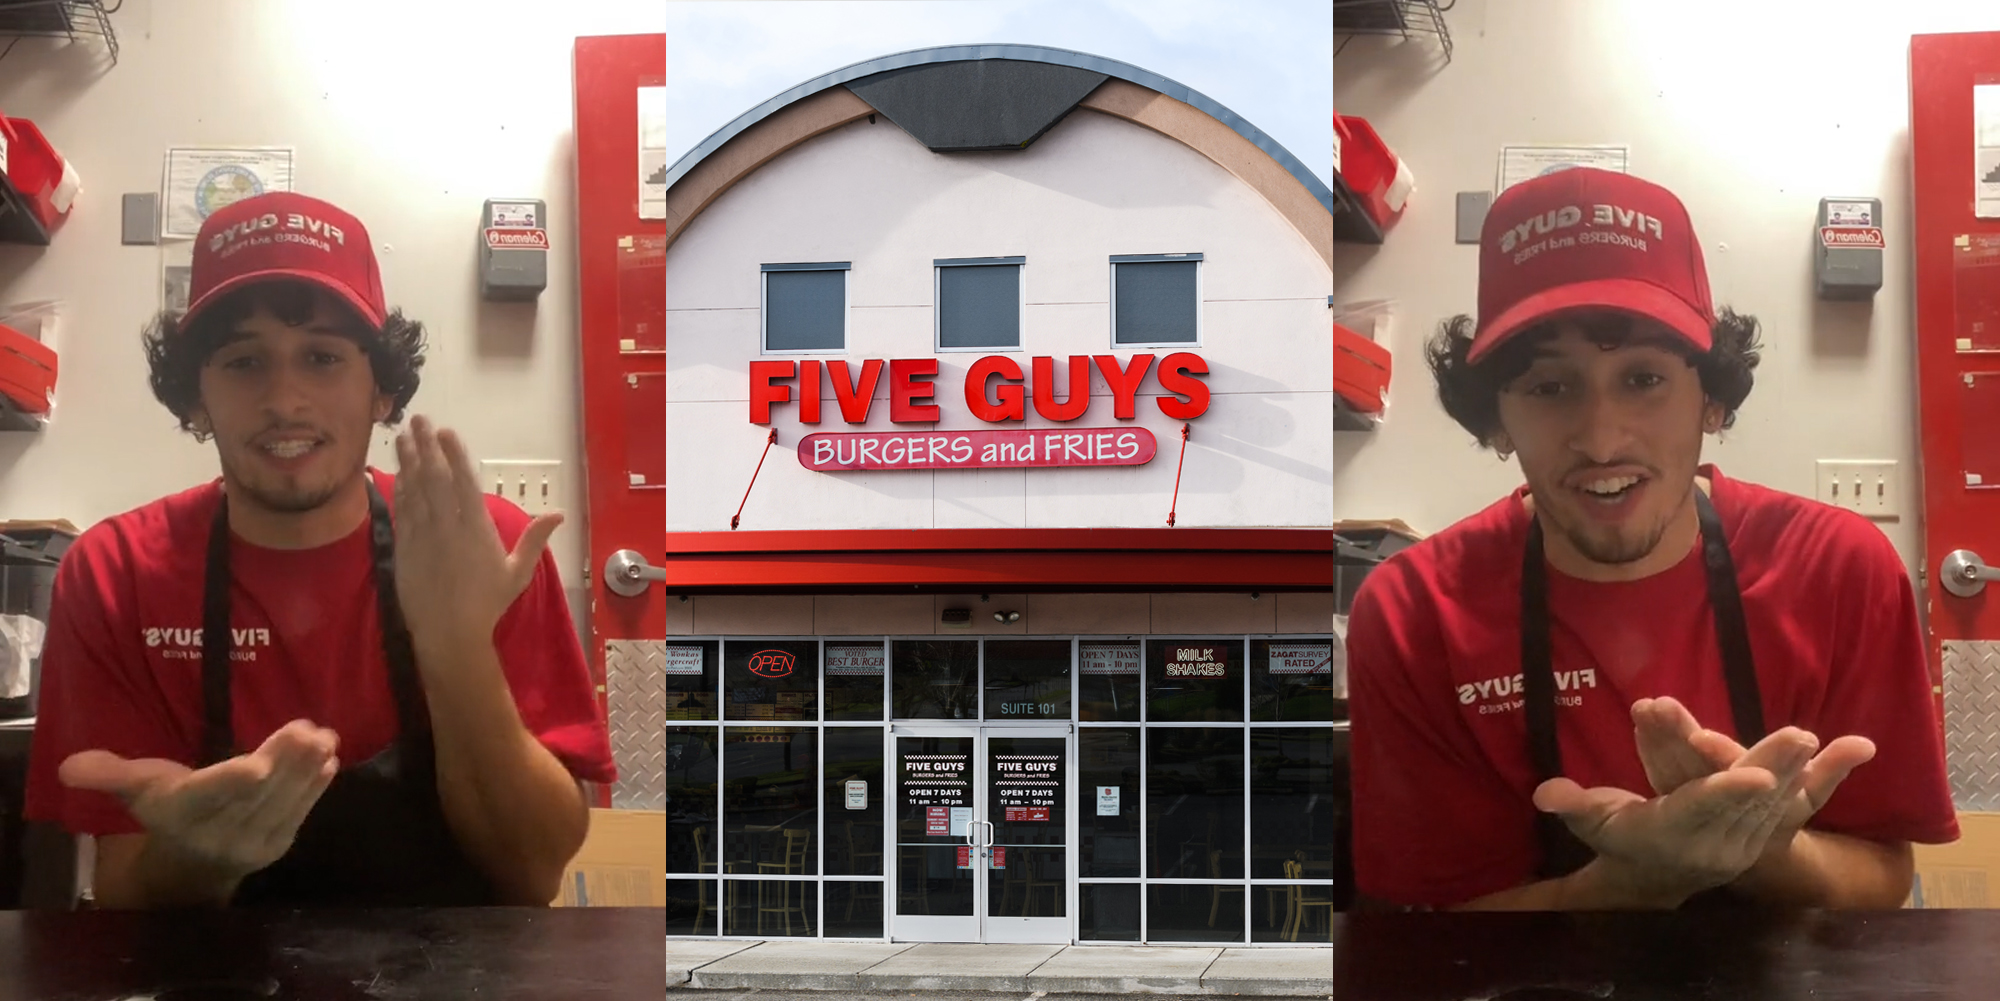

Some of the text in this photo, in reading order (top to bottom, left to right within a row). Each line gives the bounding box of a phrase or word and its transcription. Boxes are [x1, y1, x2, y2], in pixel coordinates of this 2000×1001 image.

[748, 351, 1212, 424] FIVE GUYS
[812, 432, 1141, 466] BURGERS and FRIES
[1081, 651, 1139, 659] OPEN 7 DAYS
[1176, 648, 1214, 662] MILK
[748, 655, 796, 672] OPEN
[827, 657, 848, 666] BEST
[1082, 660, 1090, 668] 11
[1114, 660, 1122, 668] 10
[1124, 662, 1138, 670] pm
[1284, 659, 1316, 667] RATED
[1166, 662, 1225, 677] SHAKES
[1001, 703, 1055, 714] SUITE 101
[906, 762, 965, 771] FIVE GUYS
[997, 763, 1056, 771] FIVE GUYS
